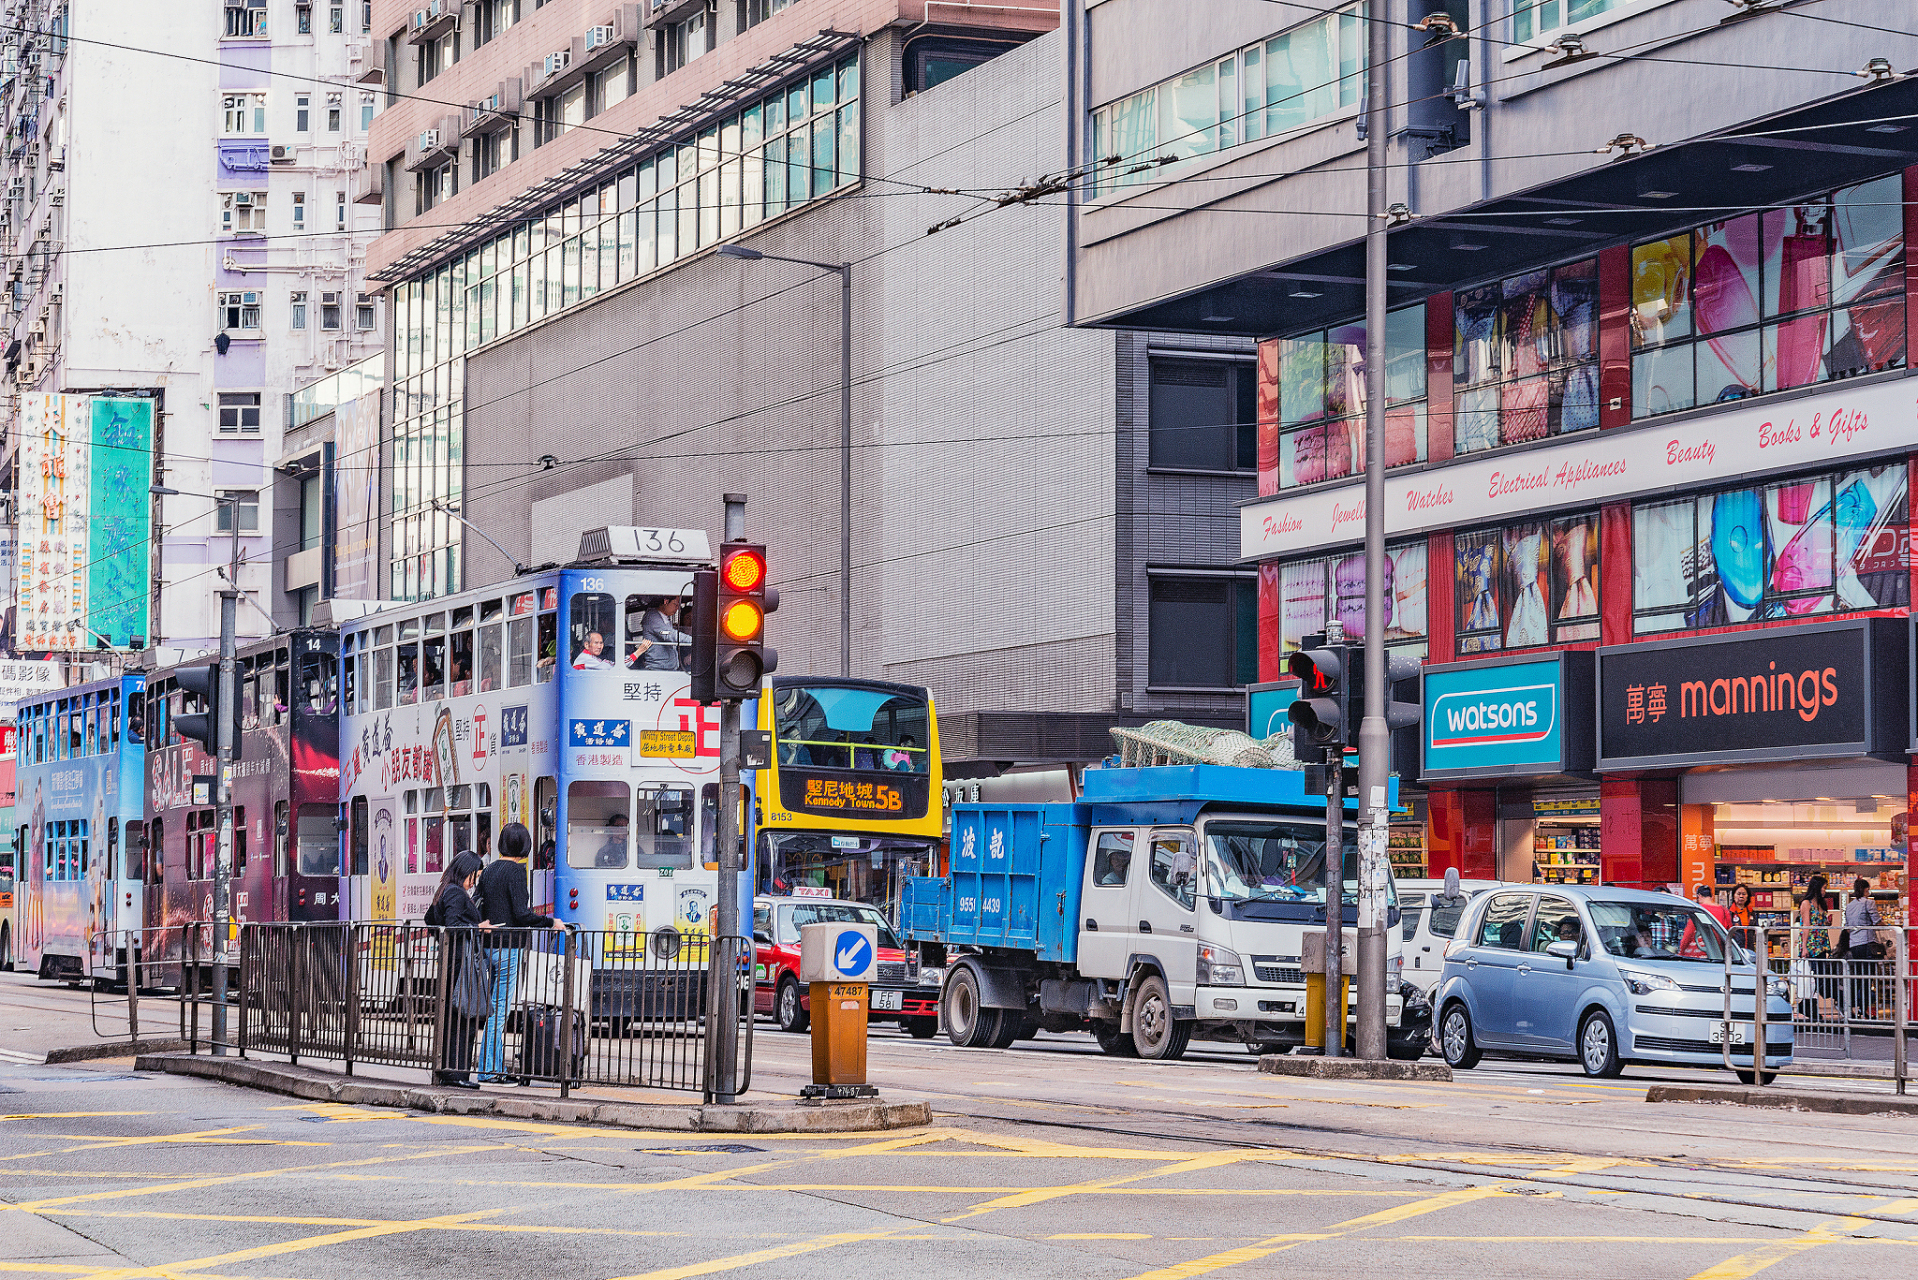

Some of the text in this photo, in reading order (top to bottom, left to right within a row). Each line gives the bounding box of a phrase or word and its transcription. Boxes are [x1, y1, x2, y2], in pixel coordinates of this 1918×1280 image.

[1262, 407, 1869, 541] Fashion Jewell Watches Electrical Appliances Beauty Books & Gifts
[633, 529, 685, 553] 136
[580, 577, 604, 591] 136
[306, 638, 321, 651] 14
[623, 682, 662, 702] 堅持
[1626, 660, 1838, 725] 萬寧 mannings
[1447, 701, 1538, 732] watsons
[473, 714, 486, 759] 正
[574, 721, 627, 738] 黃道益
[641, 731, 694, 742] Whitty Street Depot
[575, 754, 623, 766] 香港製造
[807, 779, 873, 799] 堅尼地城
[805, 794, 875, 809] Kennedy Town
[875, 785, 902, 811] 5B
[771, 812, 792, 821] 8153
[961, 826, 1005, 860] 波記
[1684, 834, 1713, 851] 萬寧
[798, 888, 829, 897] TAXI
[982, 896, 1001, 913] 4439
[834, 986, 863, 996] 47487
[879, 999, 895, 1009] 581
